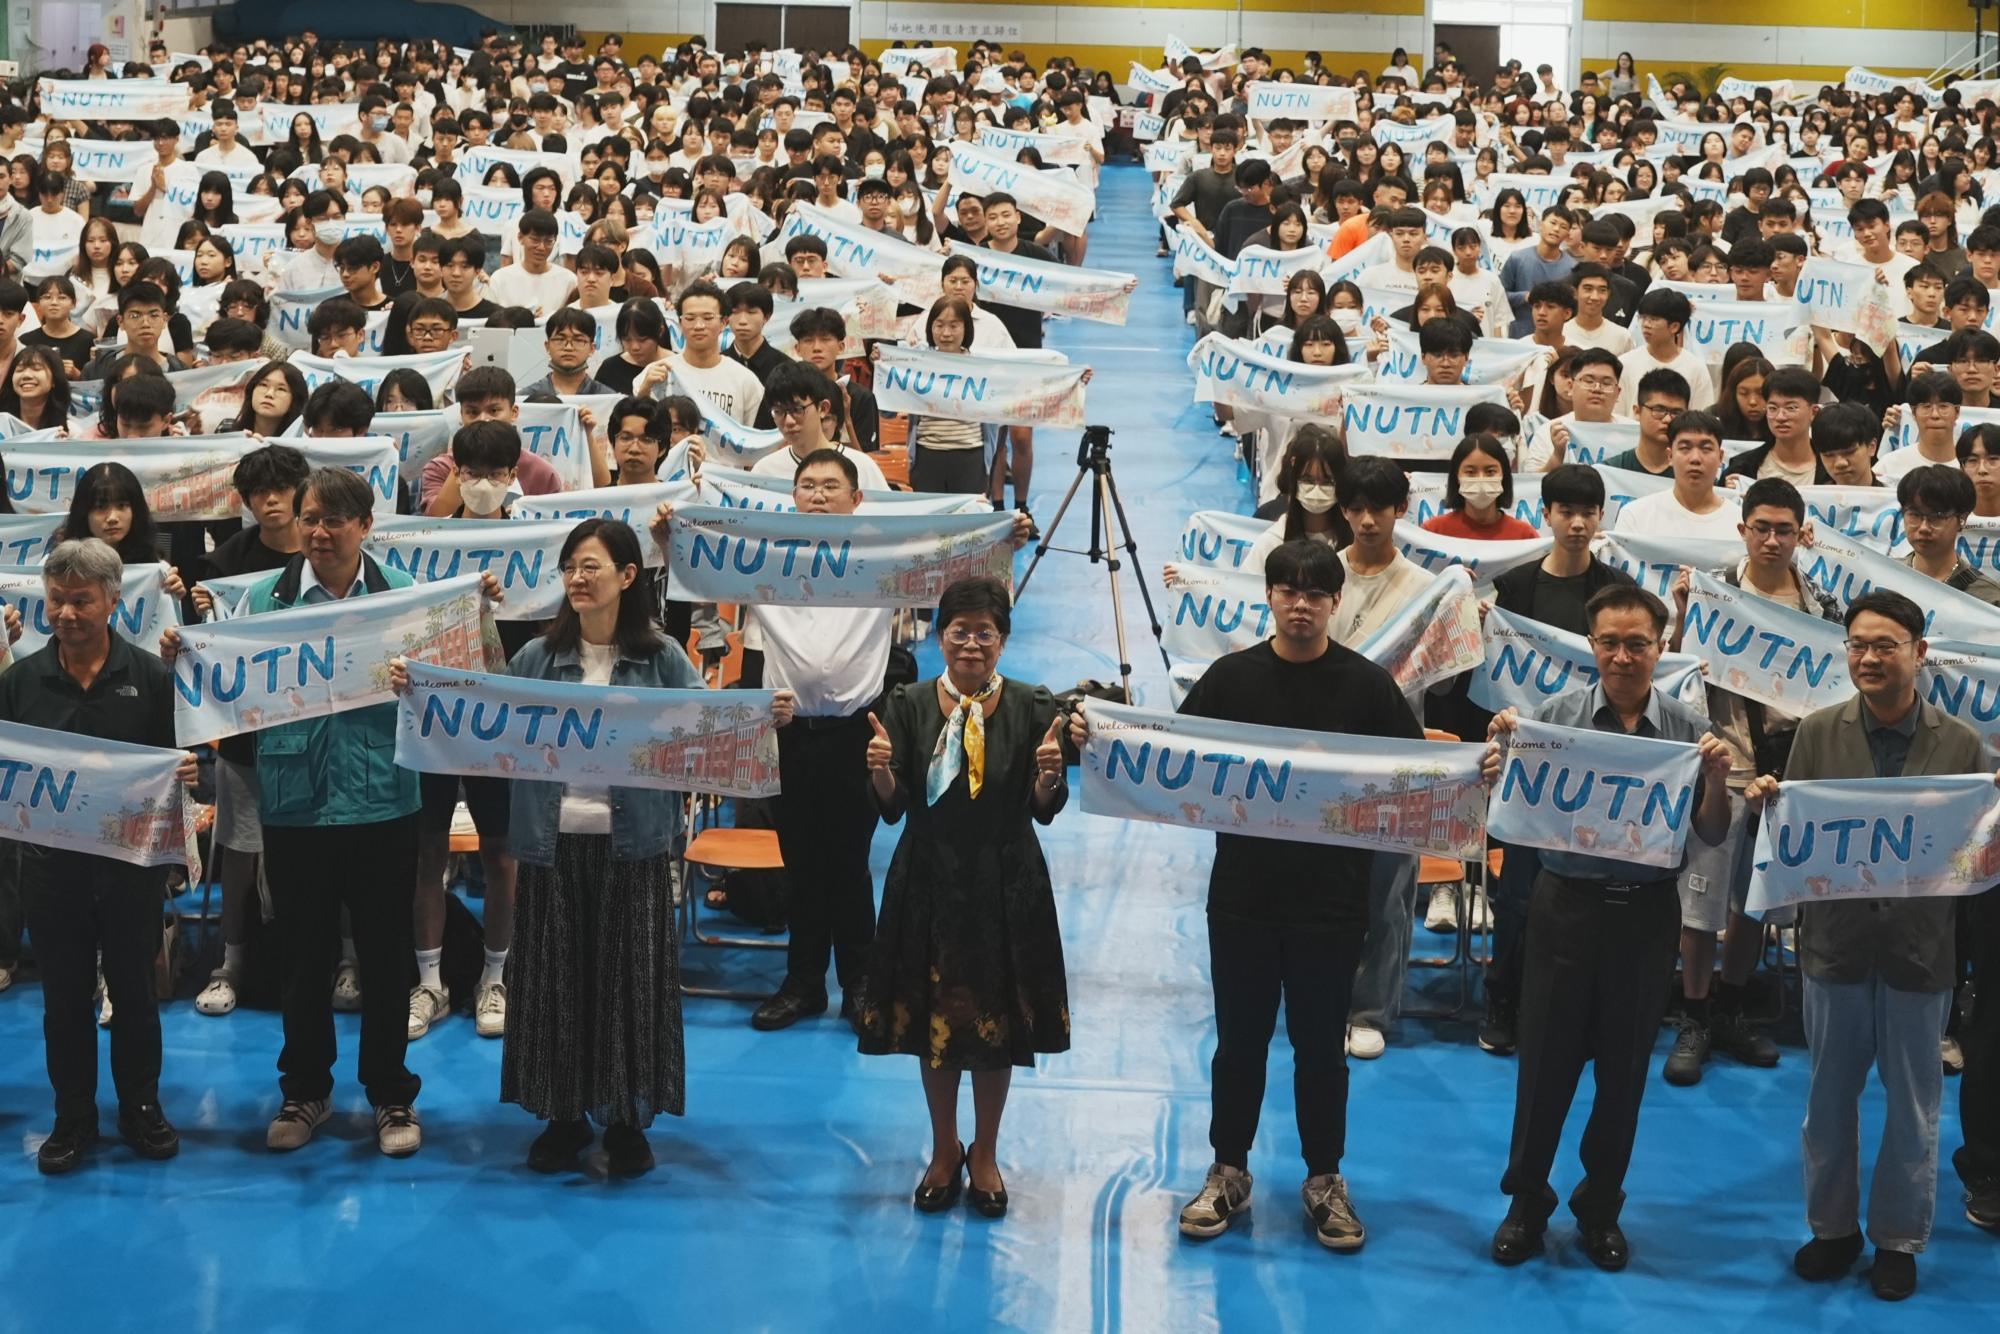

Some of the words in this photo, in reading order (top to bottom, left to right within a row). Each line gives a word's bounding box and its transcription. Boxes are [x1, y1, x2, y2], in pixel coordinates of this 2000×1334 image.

[61, 92, 126, 107] NUTN
[1256, 92, 1311, 107] NUTN
[1139, 119, 1164, 132] NU
[1663, 131, 1703, 145] NUT
[982, 133, 1036, 150] NUTN
[167, 186, 196, 206] NU
[466, 200, 521, 219] NUT
[231, 236, 289, 256] UTN
[657, 226, 723, 249] NUTN
[977, 264, 1044, 294] UTN
[1232, 258, 1281, 279] UTN
[1797, 277, 1843, 309] UTN
[1688, 319, 1765, 345] UTN
[886, 366, 987, 401] NUTN
[1344, 403, 1460, 437] NUTN
[373, 532, 416, 543] Welcome
[1182, 528, 1254, 568] NUT
[690, 534, 851, 579] NUTN
[1957, 536, 2000, 571] NU
[386, 547, 544, 590] NUTN
[1723, 595, 1733, 603] to
[1175, 591, 1273, 638] NUT
[196, 642, 206, 651] to
[1493, 627, 1534, 640] Welcome
[1683, 601, 1833, 688] NUTN
[174, 636, 335, 707] NUTN
[1491, 644, 1600, 695] NUT
[1921, 657, 1963, 667] Welcome
[1967, 656, 1977, 664] to
[412, 678, 459, 689] Welcome
[464, 679, 476, 687] to
[1928, 674, 2000, 722] NU
[420, 693, 604, 750] NUTN
[1097, 721, 1147, 731] Welcome
[1151, 722, 1163, 731] to
[1551, 741, 1562, 750] to
[1106, 738, 1291, 803] NUTN
[0, 758, 78, 813] TN
[1501, 757, 1691, 832] NUTN
[1778, 814, 1914, 868] UTN
